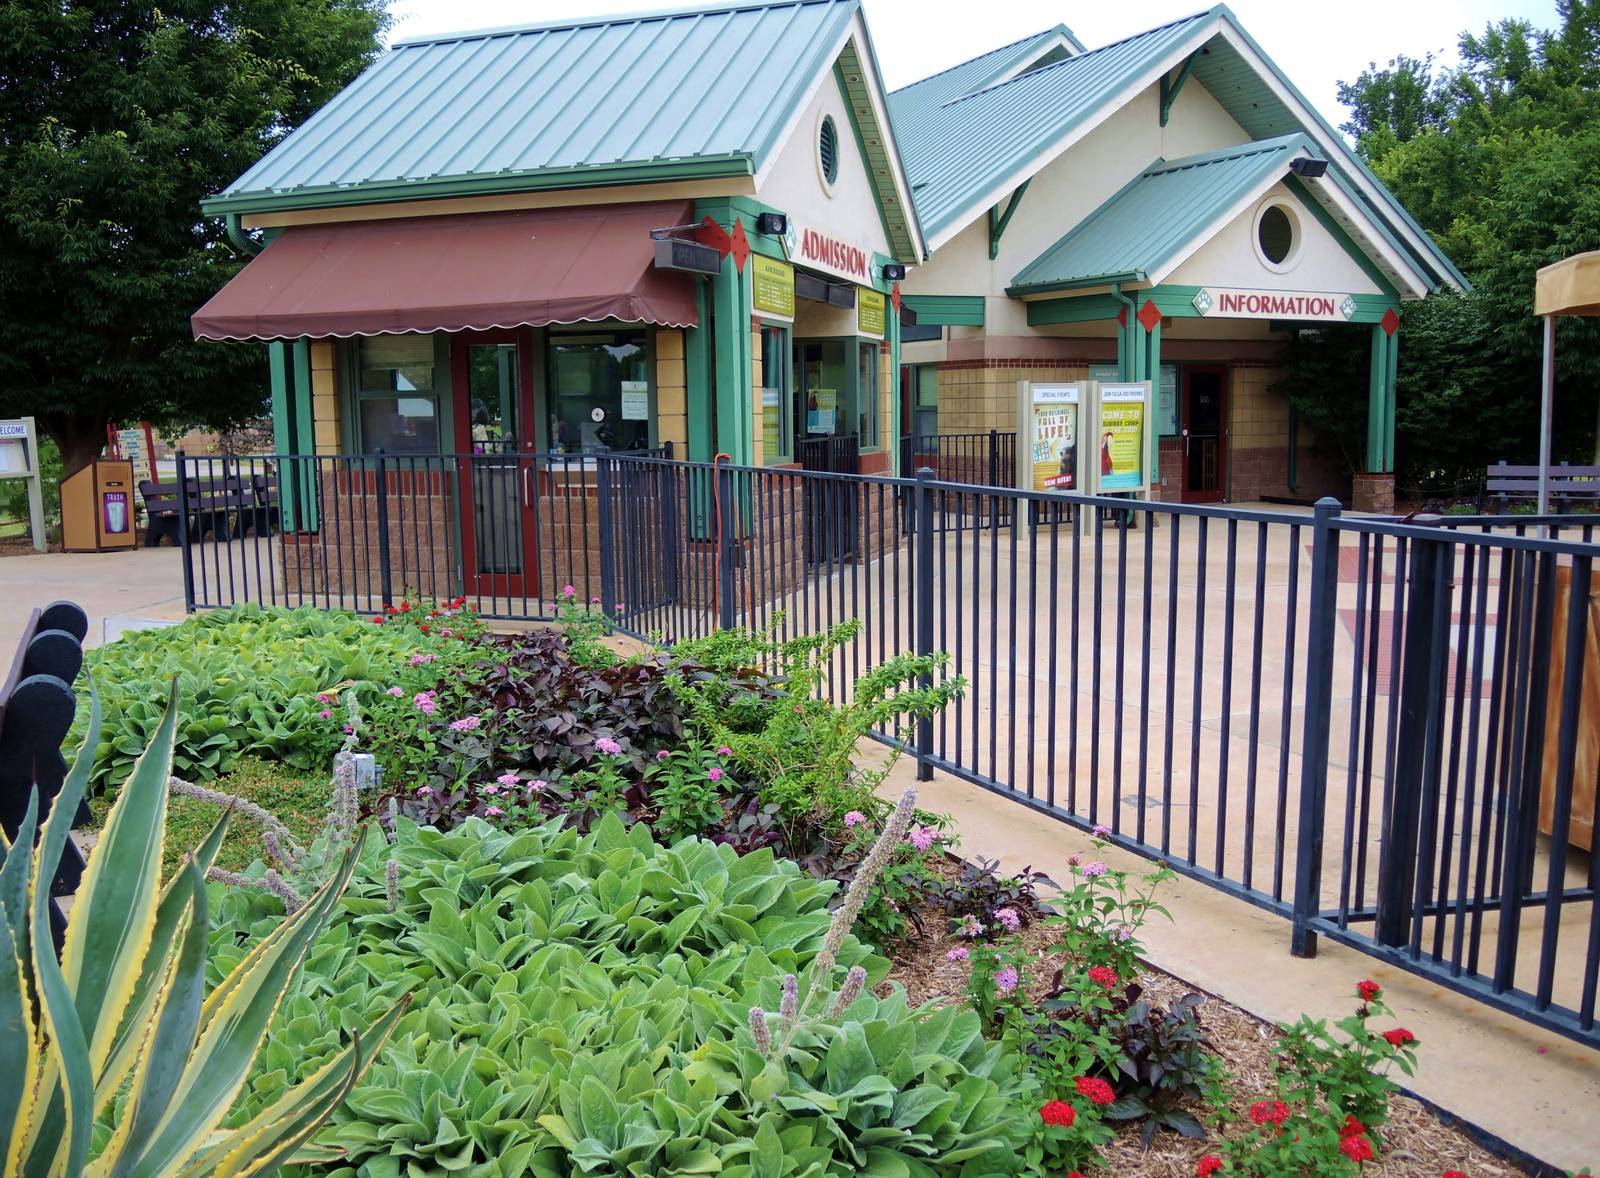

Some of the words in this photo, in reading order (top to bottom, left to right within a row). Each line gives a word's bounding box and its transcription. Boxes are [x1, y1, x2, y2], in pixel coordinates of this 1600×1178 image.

[802, 228, 866, 278] ADMISSION
[1219, 293, 1335, 316] INFORMATION
[1038, 416, 1056, 426] FULL
[1059, 415, 1068, 424] OF
[1103, 411, 1126, 419] COME
[1130, 411, 1139, 419] TO
[0, 426, 25, 435] ELCOME
[1038, 425, 1069, 440] LIFE!
[106, 493, 124, 502] TRASH
